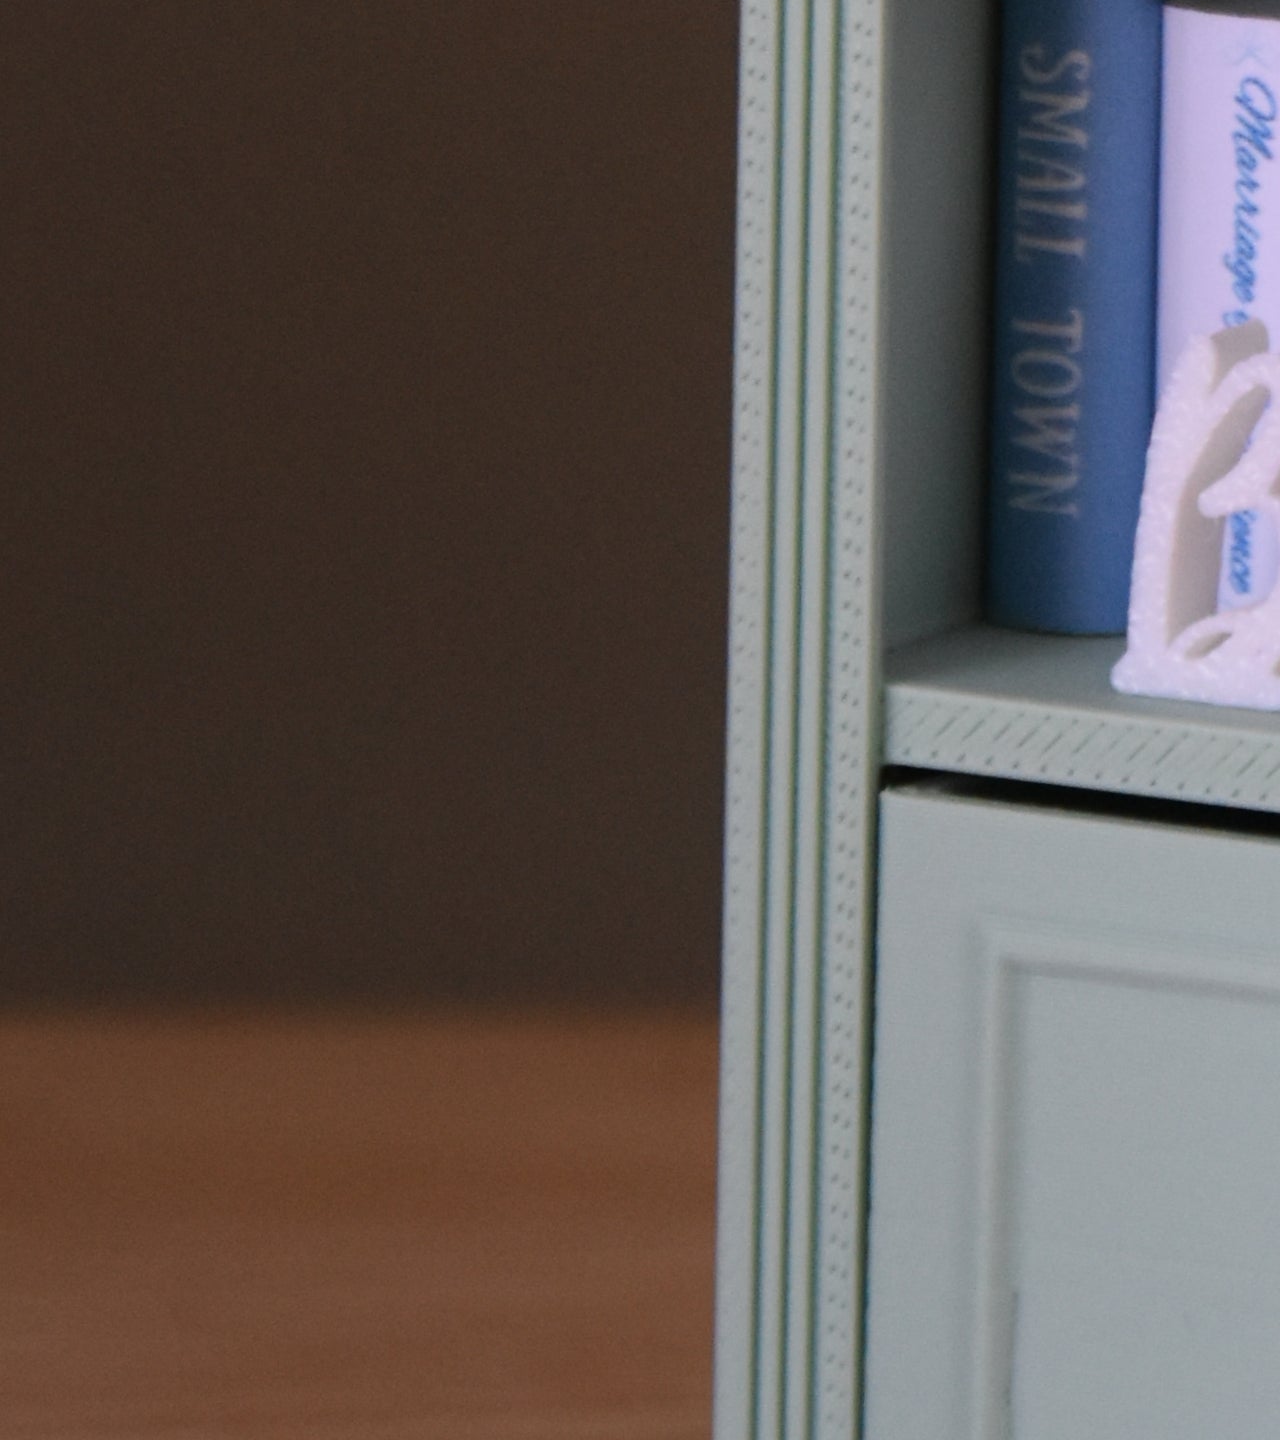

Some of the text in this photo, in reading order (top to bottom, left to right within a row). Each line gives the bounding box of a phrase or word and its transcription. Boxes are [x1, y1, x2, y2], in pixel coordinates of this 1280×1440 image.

[1007, 40, 1094, 519] SMALL TOWN
[1222, 75, 1278, 304] Marriage
